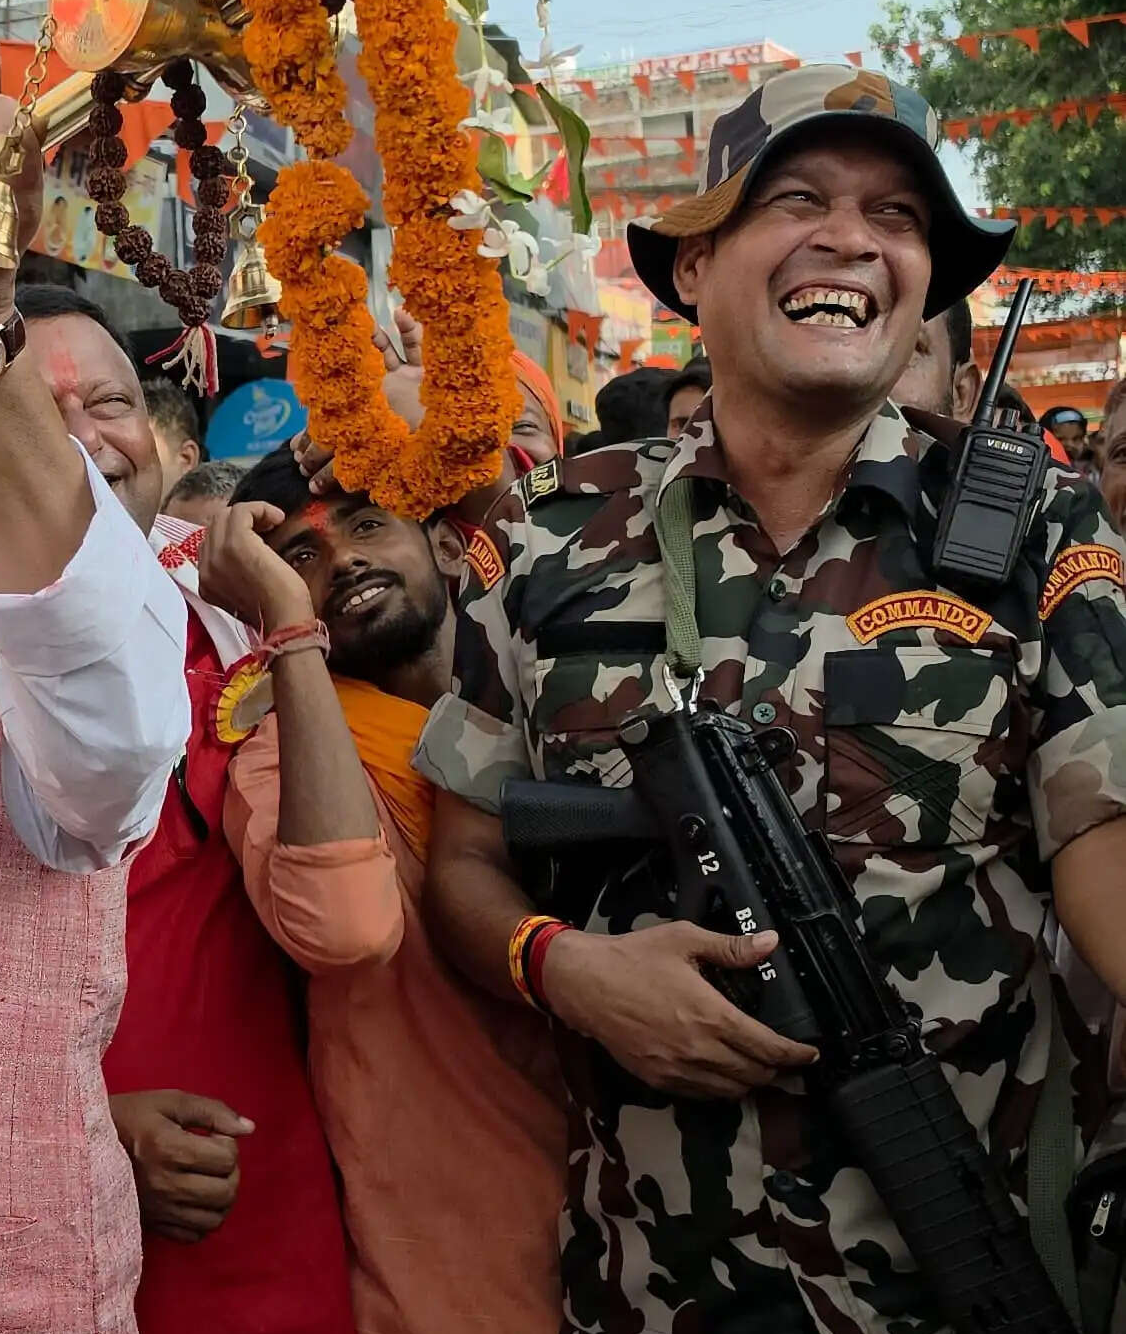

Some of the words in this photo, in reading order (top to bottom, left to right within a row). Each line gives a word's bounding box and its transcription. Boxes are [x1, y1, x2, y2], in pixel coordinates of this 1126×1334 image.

[986, 438, 1025, 455] VENUS
[859, 599, 978, 632] COMMANDO
[697, 850, 720, 876] 12
